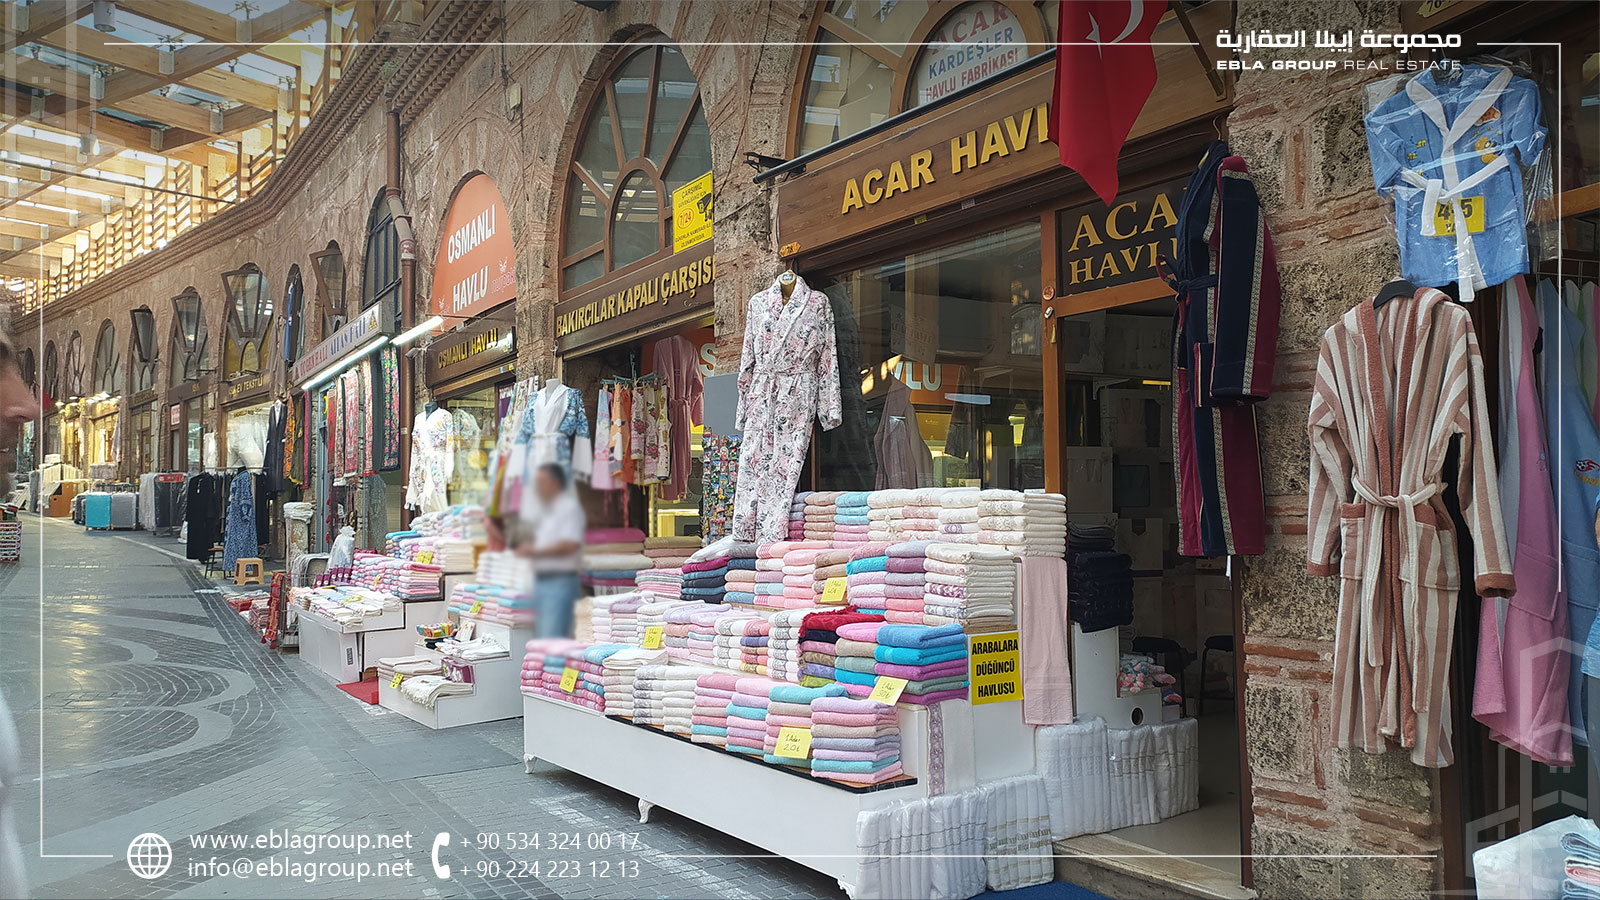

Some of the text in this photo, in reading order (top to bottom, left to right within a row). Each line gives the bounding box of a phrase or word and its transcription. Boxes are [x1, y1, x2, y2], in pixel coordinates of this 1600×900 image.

[929, 27, 1013, 79] KARDEŞLER
[932, 3, 1009, 55] ACAR
[926, 47, 1018, 102] HAVLU FABRİKASI
[841, 150, 936, 214] ACAR
[447, 203, 497, 264] OSMANLI
[1068, 190, 1182, 252] ACA
[452, 266, 489, 313] HAVLU
[555, 295, 616, 338] BAKIRCILAR
[617, 277, 659, 316] KAPALI
[437, 327, 498, 369] OSMANLI HAVLU
[971, 639, 1019, 655] ARABALARA
[976, 658, 1015, 677] DÜĞÜNCÜ
[978, 681, 1015, 698] HAVLUSU
